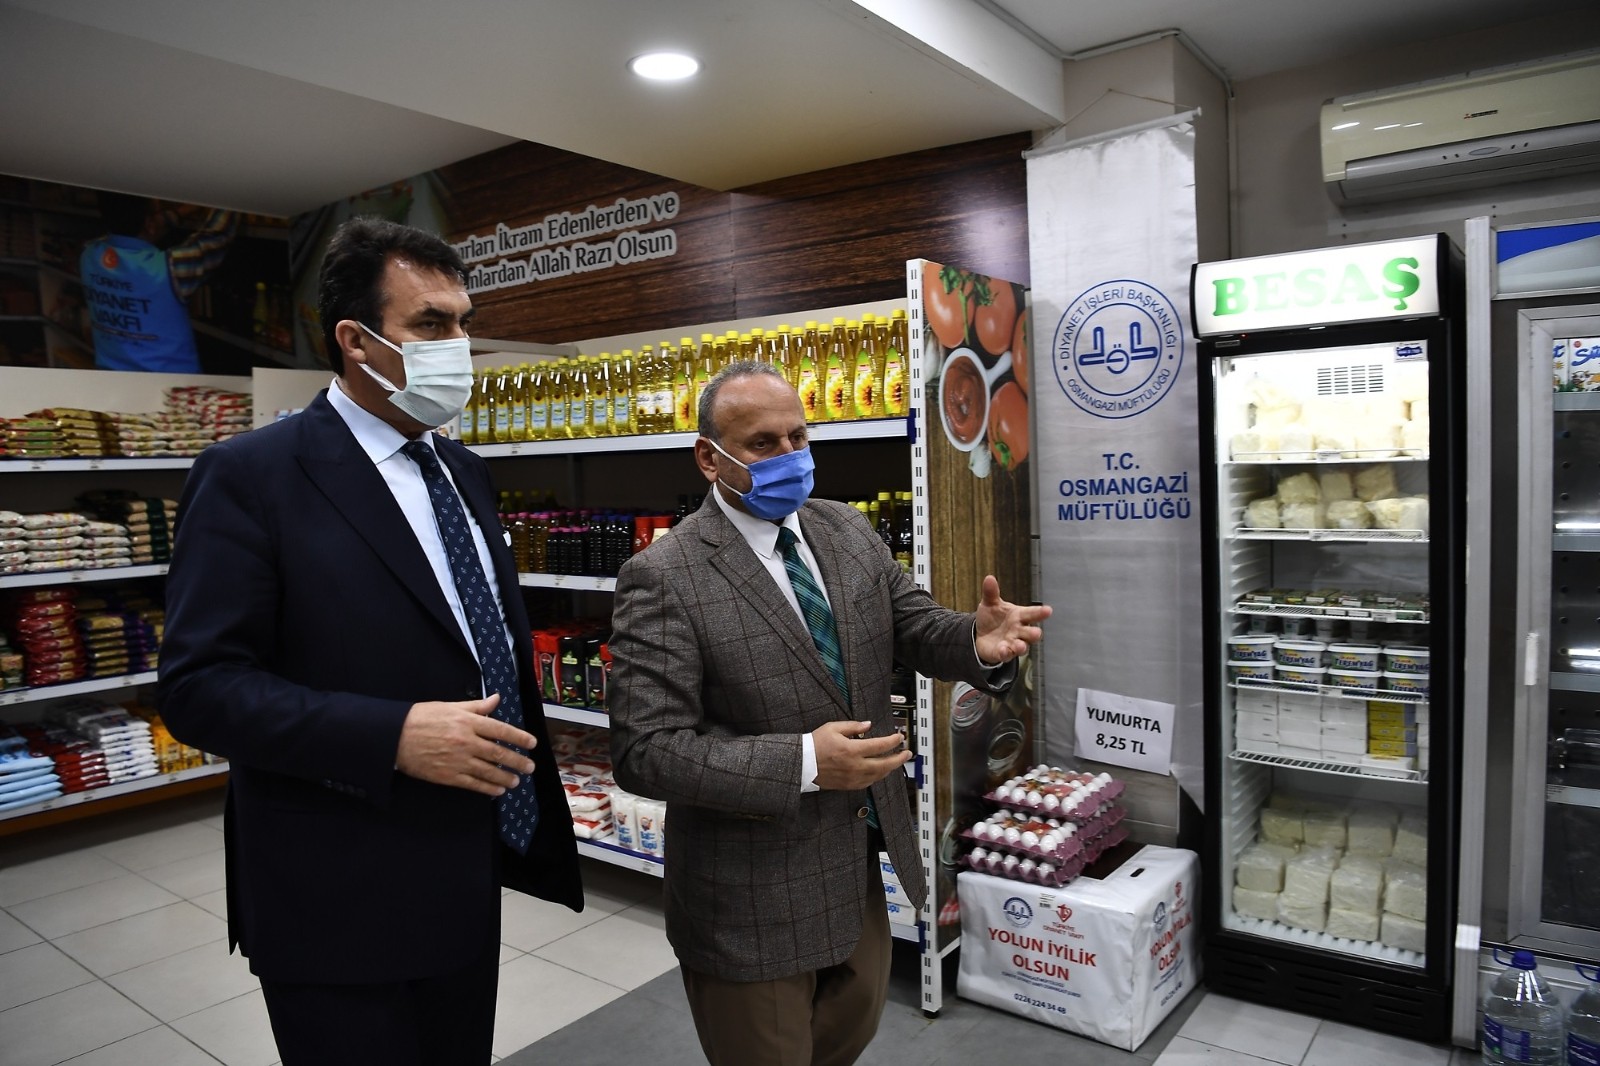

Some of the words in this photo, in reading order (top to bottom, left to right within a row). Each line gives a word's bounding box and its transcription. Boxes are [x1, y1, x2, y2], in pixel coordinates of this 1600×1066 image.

[498, 227, 543, 251] İkram
[547, 203, 648, 240] Edenlerden
[653, 196, 676, 215] ve
[464, 263, 526, 290] nlardan
[530, 252, 570, 277] Allah
[575, 246, 613, 268] Razı
[617, 233, 673, 260] Olsun
[1212, 257, 1421, 317] BESAŞ
[1058, 306, 1085, 360] DİYANET
[1083, 286, 1124, 310] İŞLERİ
[1127, 288, 1178, 348] BAŞKANLIĞI
[1067, 378, 1117, 412] OSMANGAZİ
[1118, 368, 1171, 411] MÜFTÜLÜĞÜ
[1102, 452, 1140, 471] T.C.
[1059, 471, 1188, 497] OSMANGAZİ
[1058, 497, 1191, 521] MÜFTÜLÜĞÜ
[1086, 706, 1161, 733] YUMURTA
[1096, 733, 1126, 750] 8,25
[1130, 740, 1147, 755] TL
[988, 927, 1043, 953] YOLUN
[1048, 939, 1097, 967] İYİLİK
[1012, 954, 1069, 981] OLSUN
[1031, 999, 1046, 1008] 224
